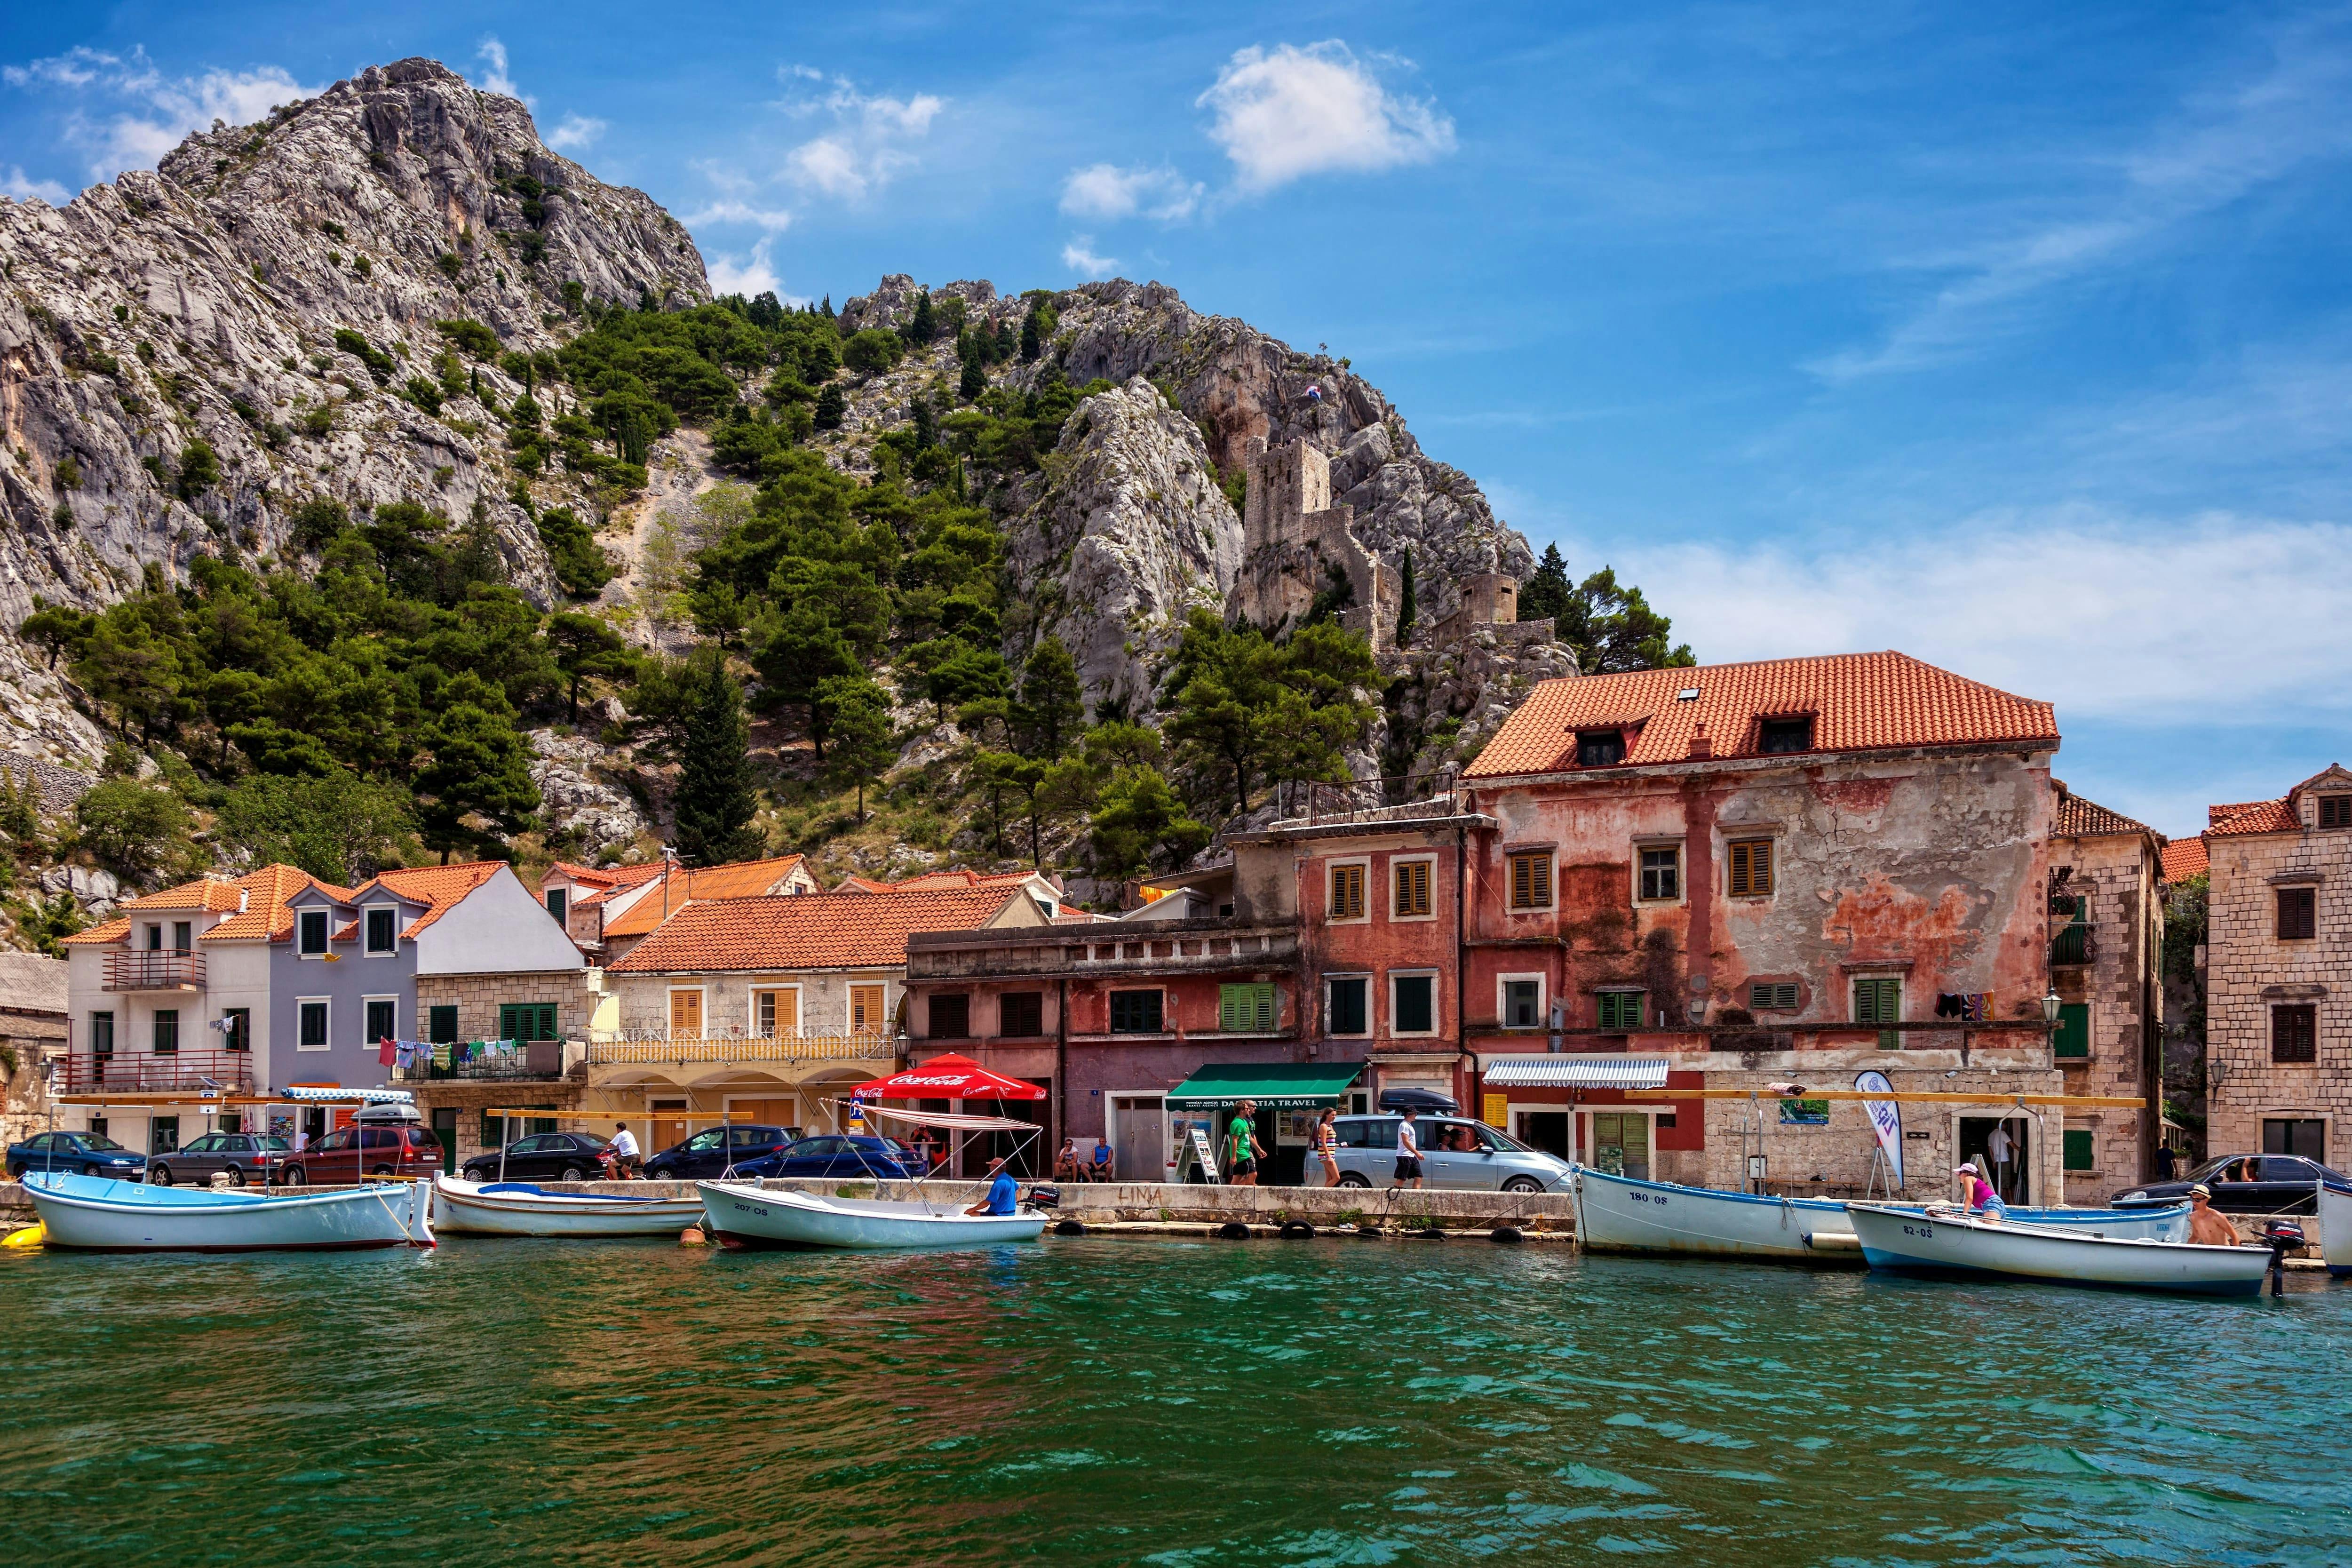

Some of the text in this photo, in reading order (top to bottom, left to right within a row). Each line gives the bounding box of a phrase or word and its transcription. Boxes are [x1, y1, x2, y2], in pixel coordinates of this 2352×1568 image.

[888, 1075, 974, 1085] Coca-Cola
[854, 1087, 885, 1097] Coca-Cola
[1118, 1186, 1162, 1205] LIMA
[1629, 1192, 1648, 1202] 180
[734, 1203, 768, 1216] 207 OS
